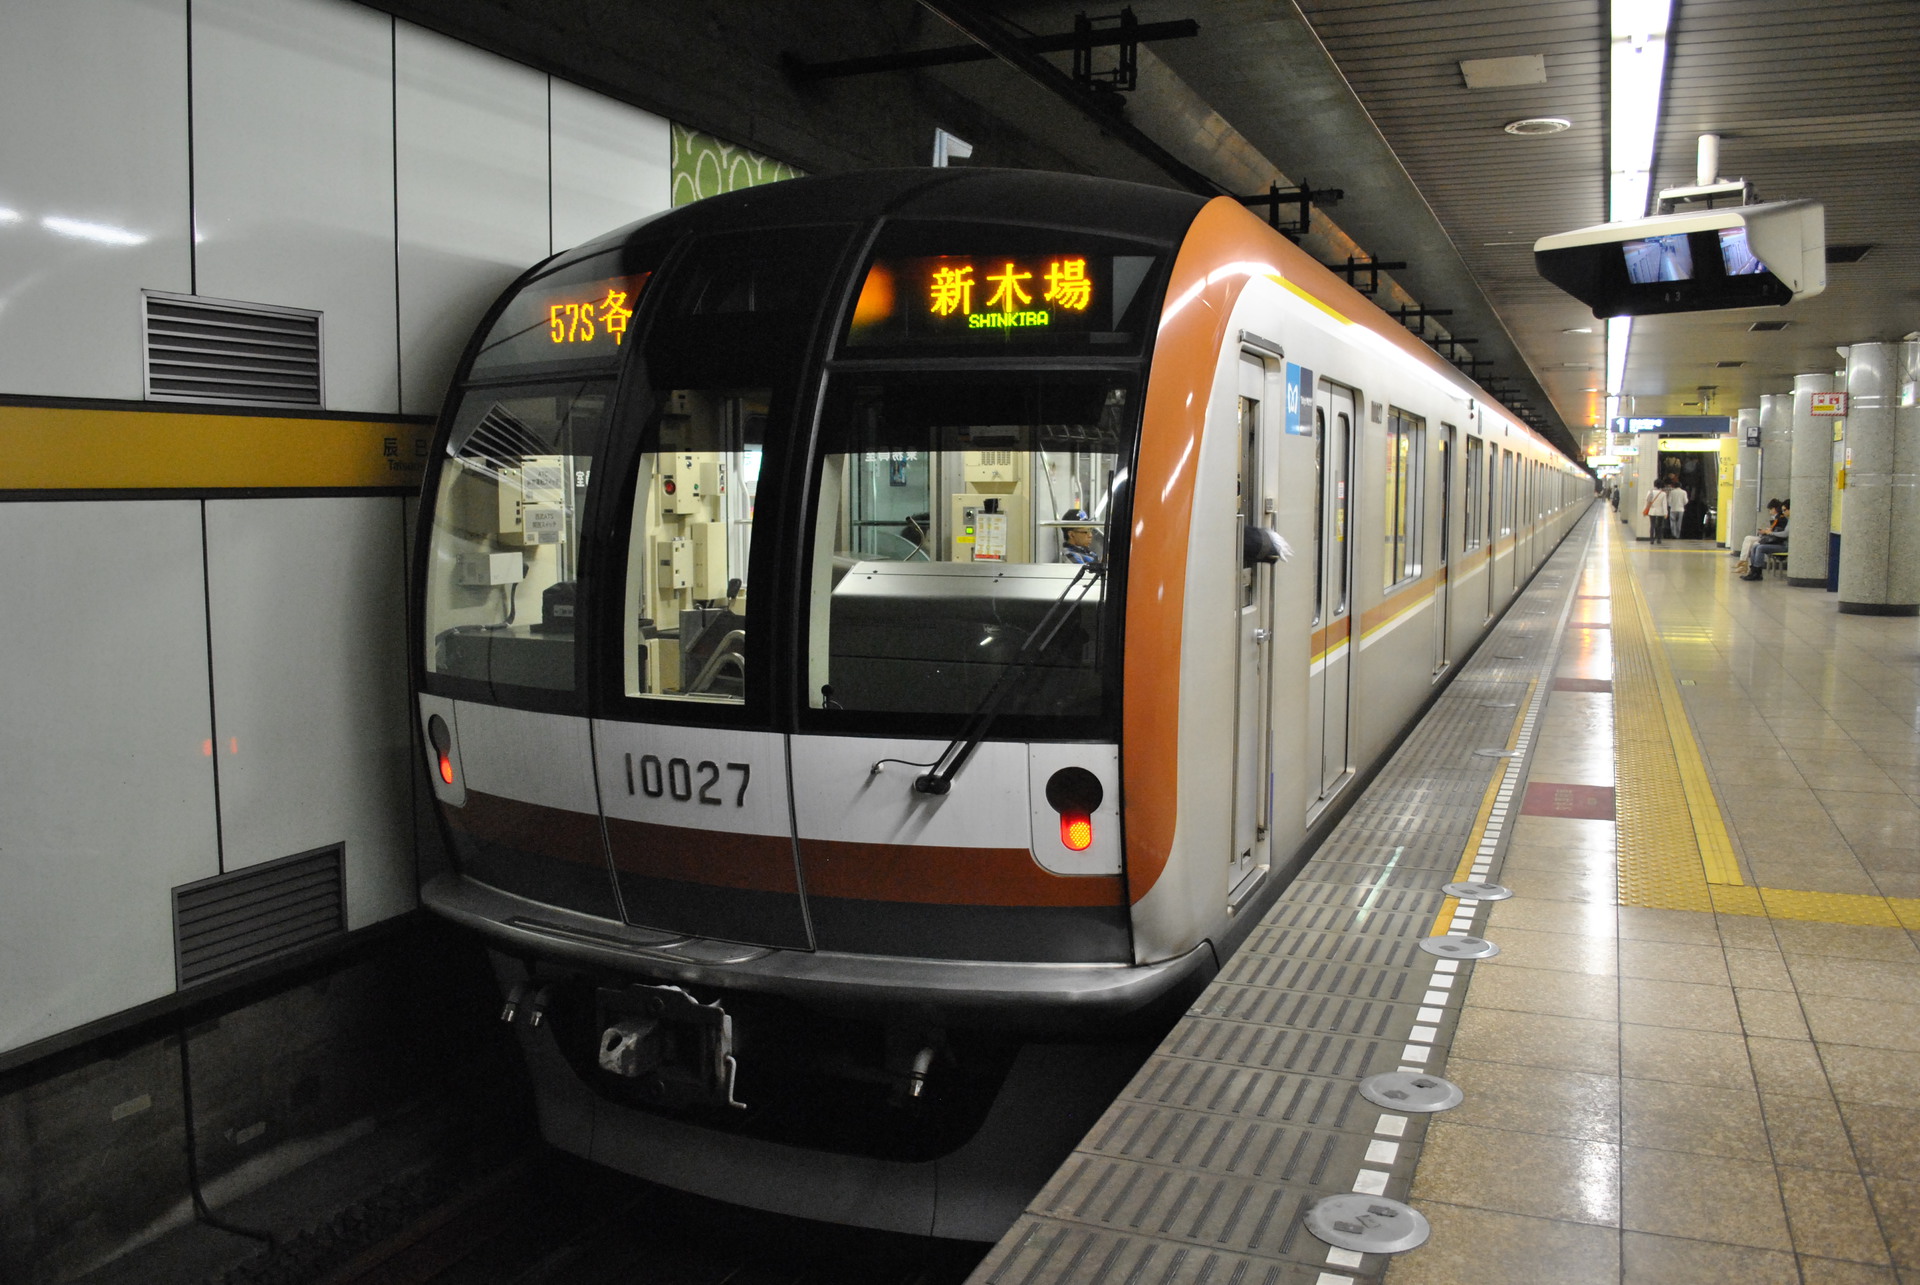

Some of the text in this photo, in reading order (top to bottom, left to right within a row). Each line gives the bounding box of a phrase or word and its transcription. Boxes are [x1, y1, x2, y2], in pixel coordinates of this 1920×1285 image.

[930, 258, 1092, 316] 新木場
[550, 303, 595, 343] 57S
[968, 311, 1049, 328] SHINKIBA
[624, 752, 750, 808] 10027
